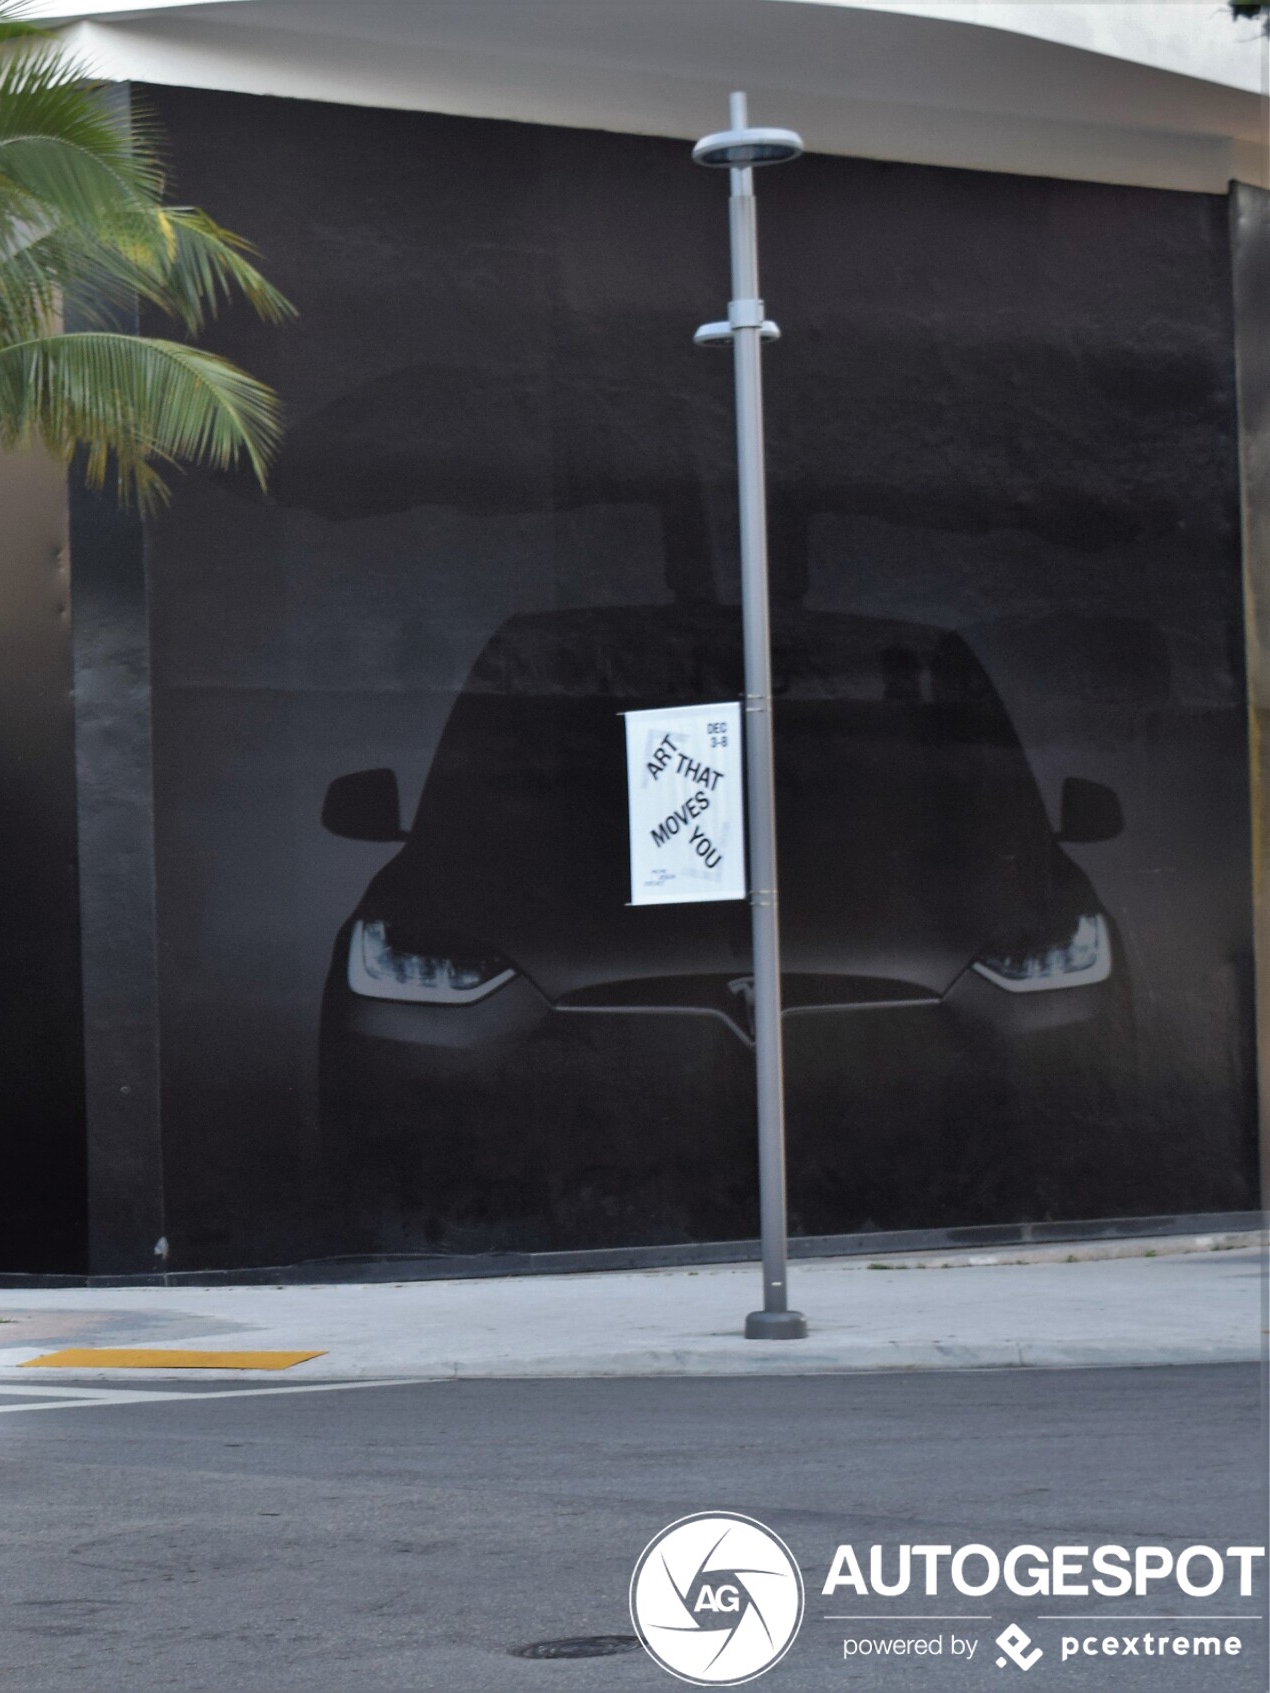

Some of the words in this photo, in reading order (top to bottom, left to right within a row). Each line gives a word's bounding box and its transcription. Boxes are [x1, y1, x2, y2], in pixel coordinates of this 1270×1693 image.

[707, 722, 727, 734] DEC
[711, 736, 728, 748] 3-8
[646, 733, 678, 780] ART
[676, 753, 725, 791] THAT
[650, 790, 710, 848] MOVES
[688, 825, 723, 869] YOU
